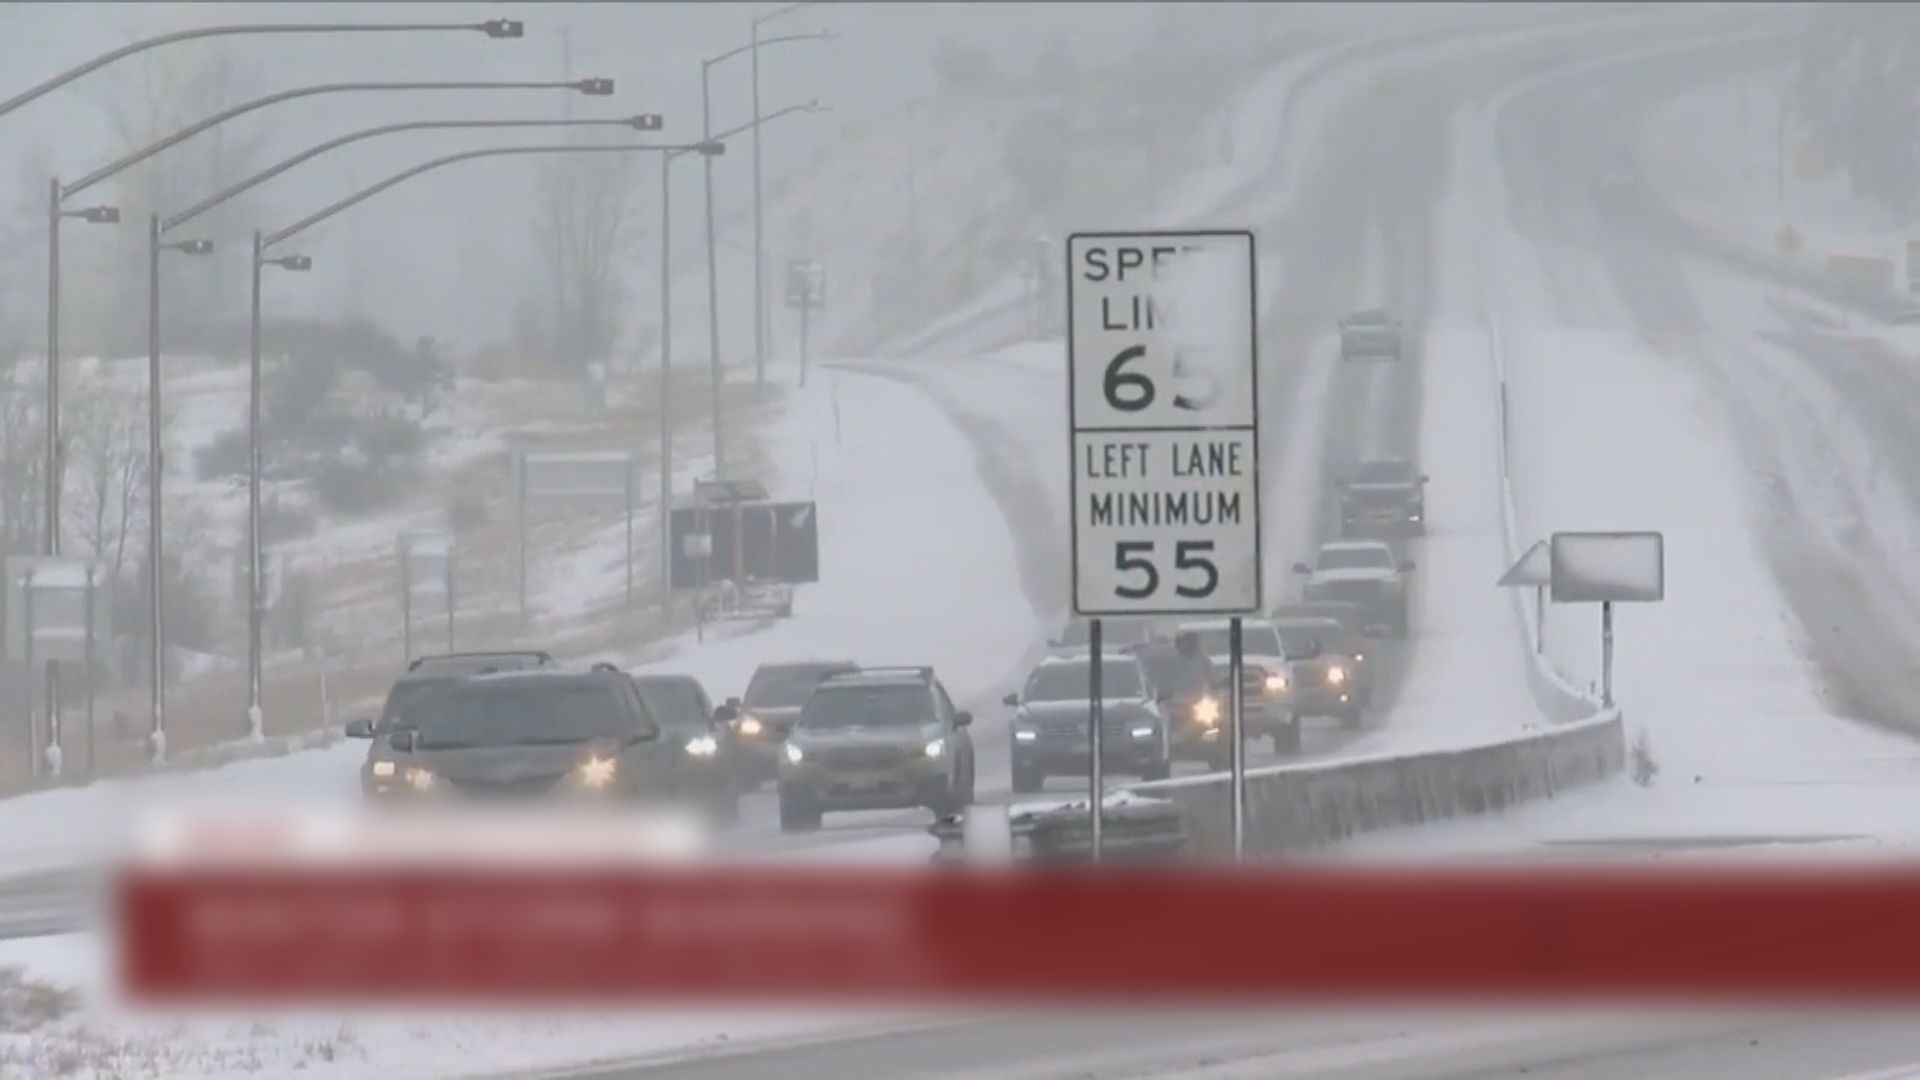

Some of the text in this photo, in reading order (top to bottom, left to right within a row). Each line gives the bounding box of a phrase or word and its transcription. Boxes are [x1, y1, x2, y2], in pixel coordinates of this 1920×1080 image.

[1084, 246, 1205, 281] SPE
[1103, 344, 1223, 412] 65
[1087, 441, 1242, 478] LEFT LANE
[1090, 490, 1241, 526] MINIMUM
[1114, 540, 1219, 599] 55
